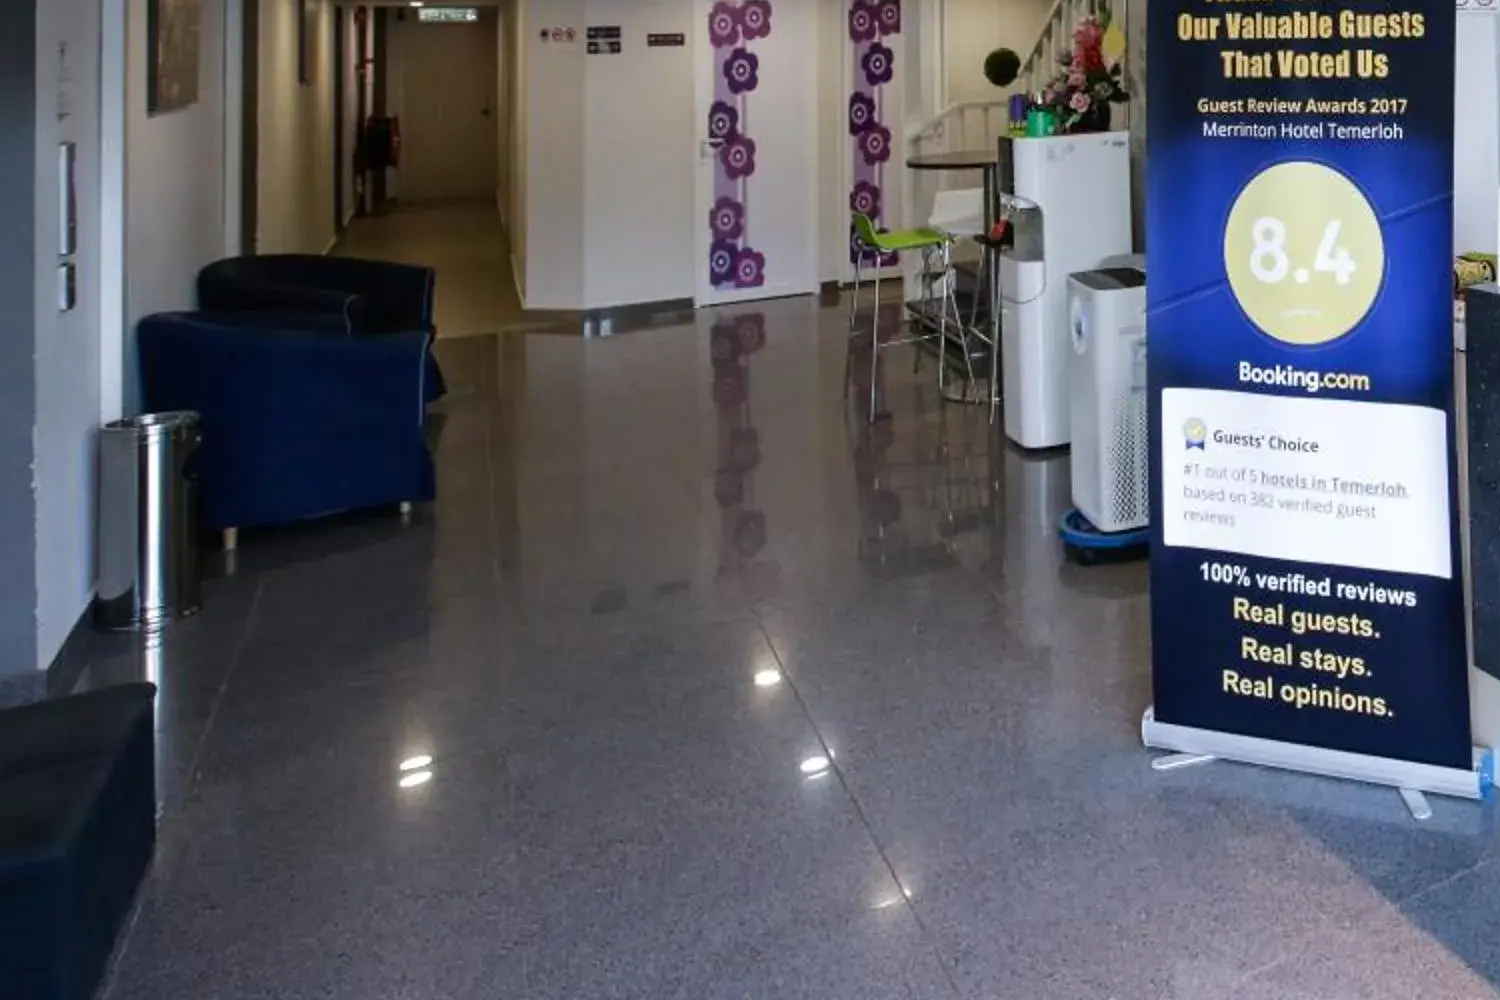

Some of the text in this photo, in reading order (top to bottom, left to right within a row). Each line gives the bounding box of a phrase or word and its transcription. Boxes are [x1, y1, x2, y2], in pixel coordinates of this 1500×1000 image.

[1178, 10, 1425, 41] Our Valuable Guests
[1221, 49, 1389, 79] That Voted Us
[1197, 98, 1407, 115] Guest Review Awards 2017
[1203, 122, 1403, 140] Merrinton Hotel Temerloh
[1250, 216, 1356, 285] 8.4
[1239, 361, 1370, 392] Booking.com
[1213, 429, 1319, 453] Guests' Choice
[1183, 463, 1200, 477] #1
[1205, 466, 1228, 480] out
[1231, 468, 1246, 482] of
[1261, 471, 1307, 489] hotels
[1311, 475, 1326, 491] in
[1183, 486, 1226, 502] based
[1229, 491, 1247, 505] on
[1277, 497, 1333, 515] verified
[1336, 502, 1377, 520] guest
[1183, 510, 1236, 528] reviews
[1200, 562, 1417, 607] 100% verified reviews
[1233, 597, 1381, 639] Real guests.
[1241, 637, 1372, 679] Real stays.
[1223, 669, 1394, 717] Real opinions.
